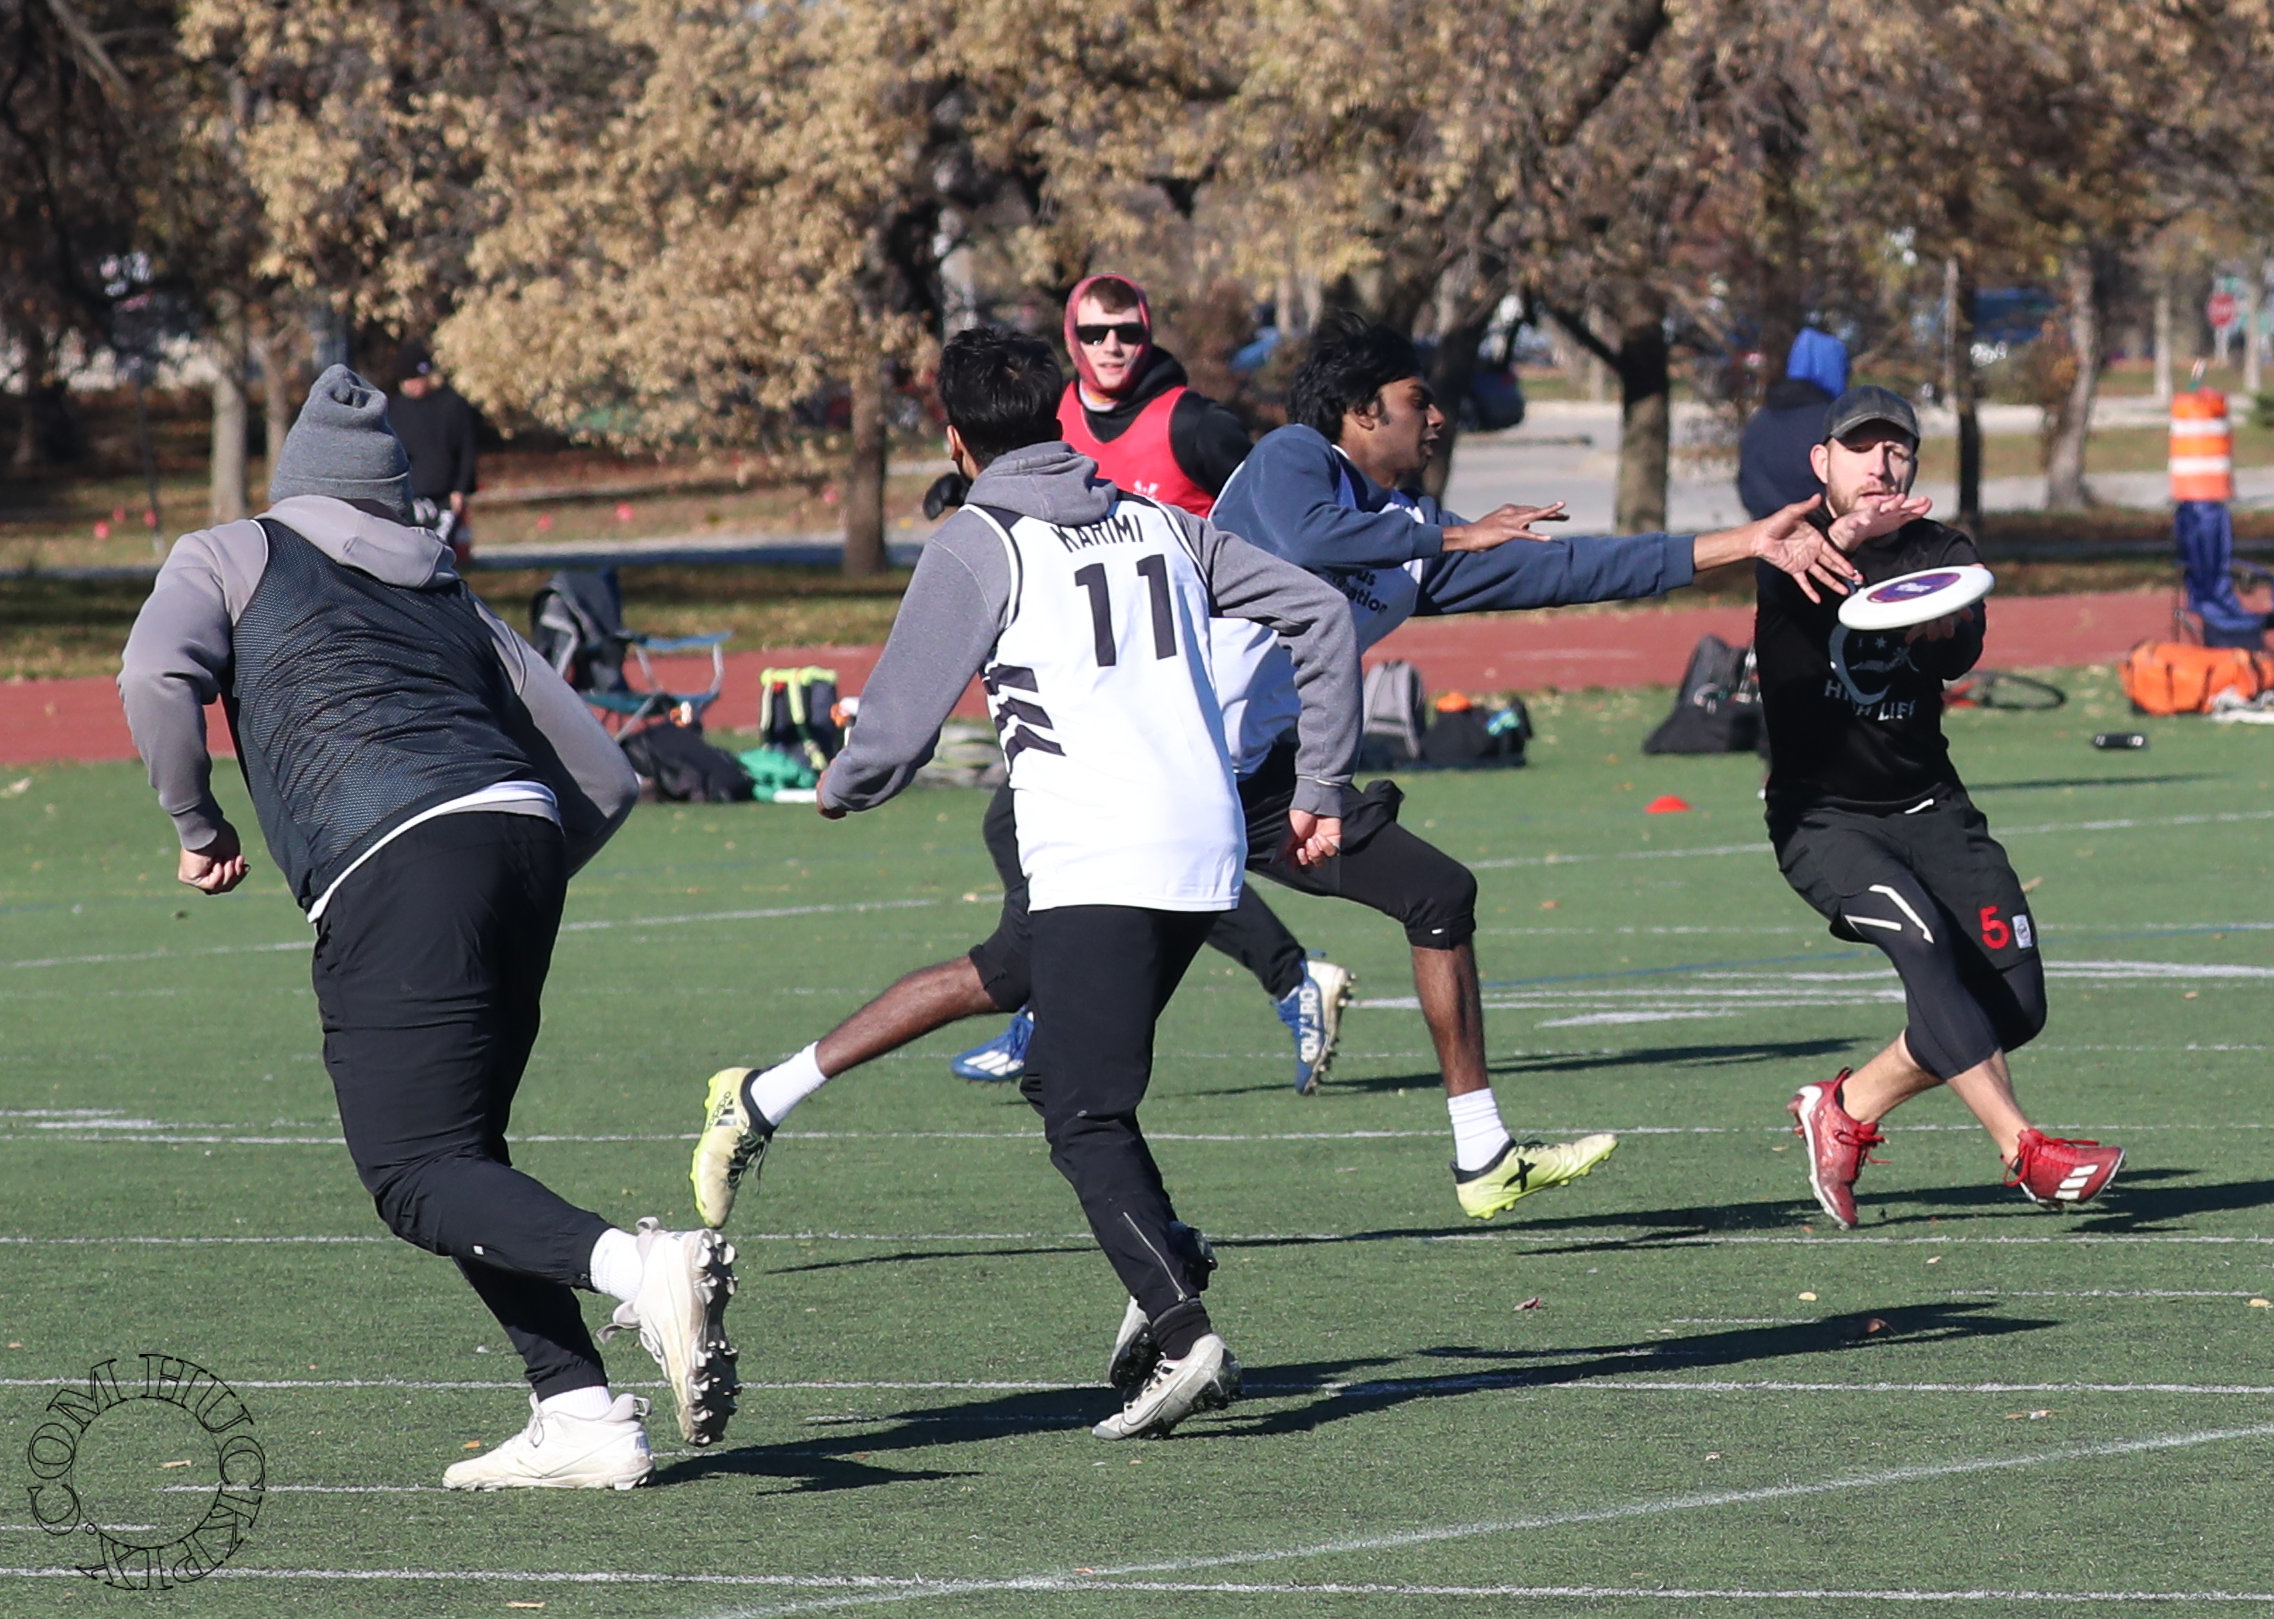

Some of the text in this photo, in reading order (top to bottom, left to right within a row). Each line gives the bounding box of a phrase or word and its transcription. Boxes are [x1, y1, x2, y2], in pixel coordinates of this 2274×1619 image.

[1050, 514, 1143, 553] KARIMI
[1074, 553, 1177, 667] 11
[1980, 905, 2011, 949] 5
